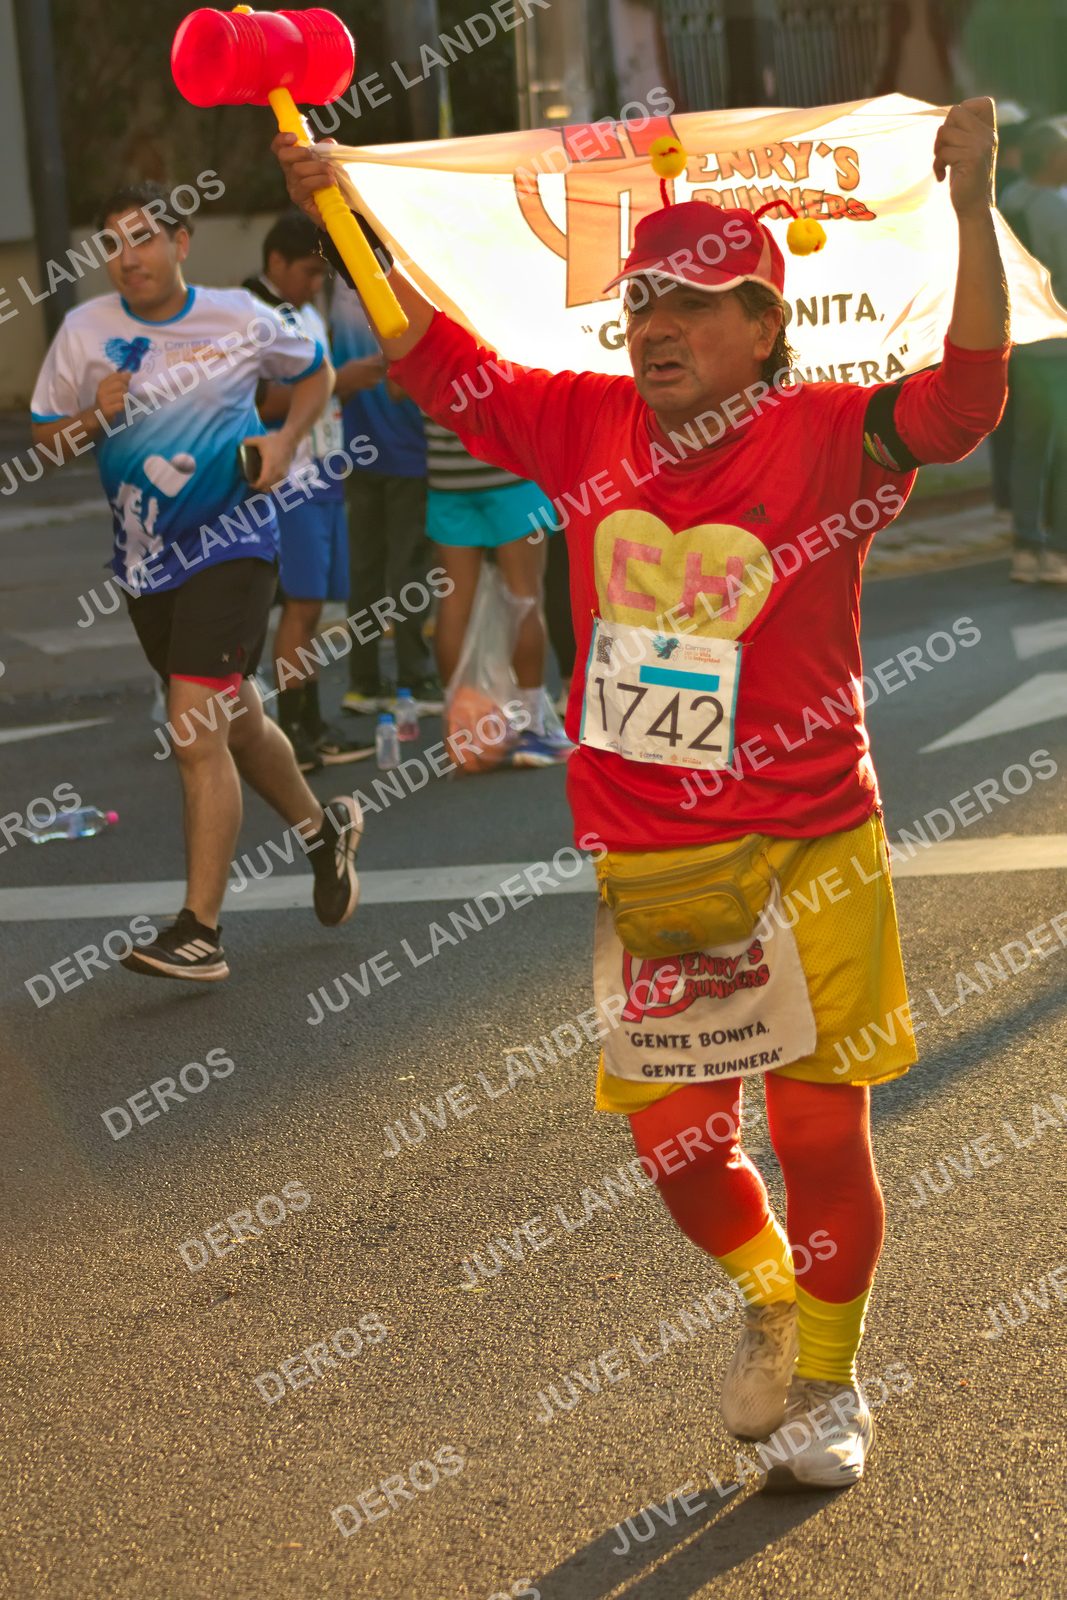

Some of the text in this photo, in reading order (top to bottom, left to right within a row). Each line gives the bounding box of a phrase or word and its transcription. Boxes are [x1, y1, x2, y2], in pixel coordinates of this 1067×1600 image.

[607, 537, 744, 622] CH
[594, 677, 724, 753] 1742
[641, 1063, 697, 1078] GENTE
